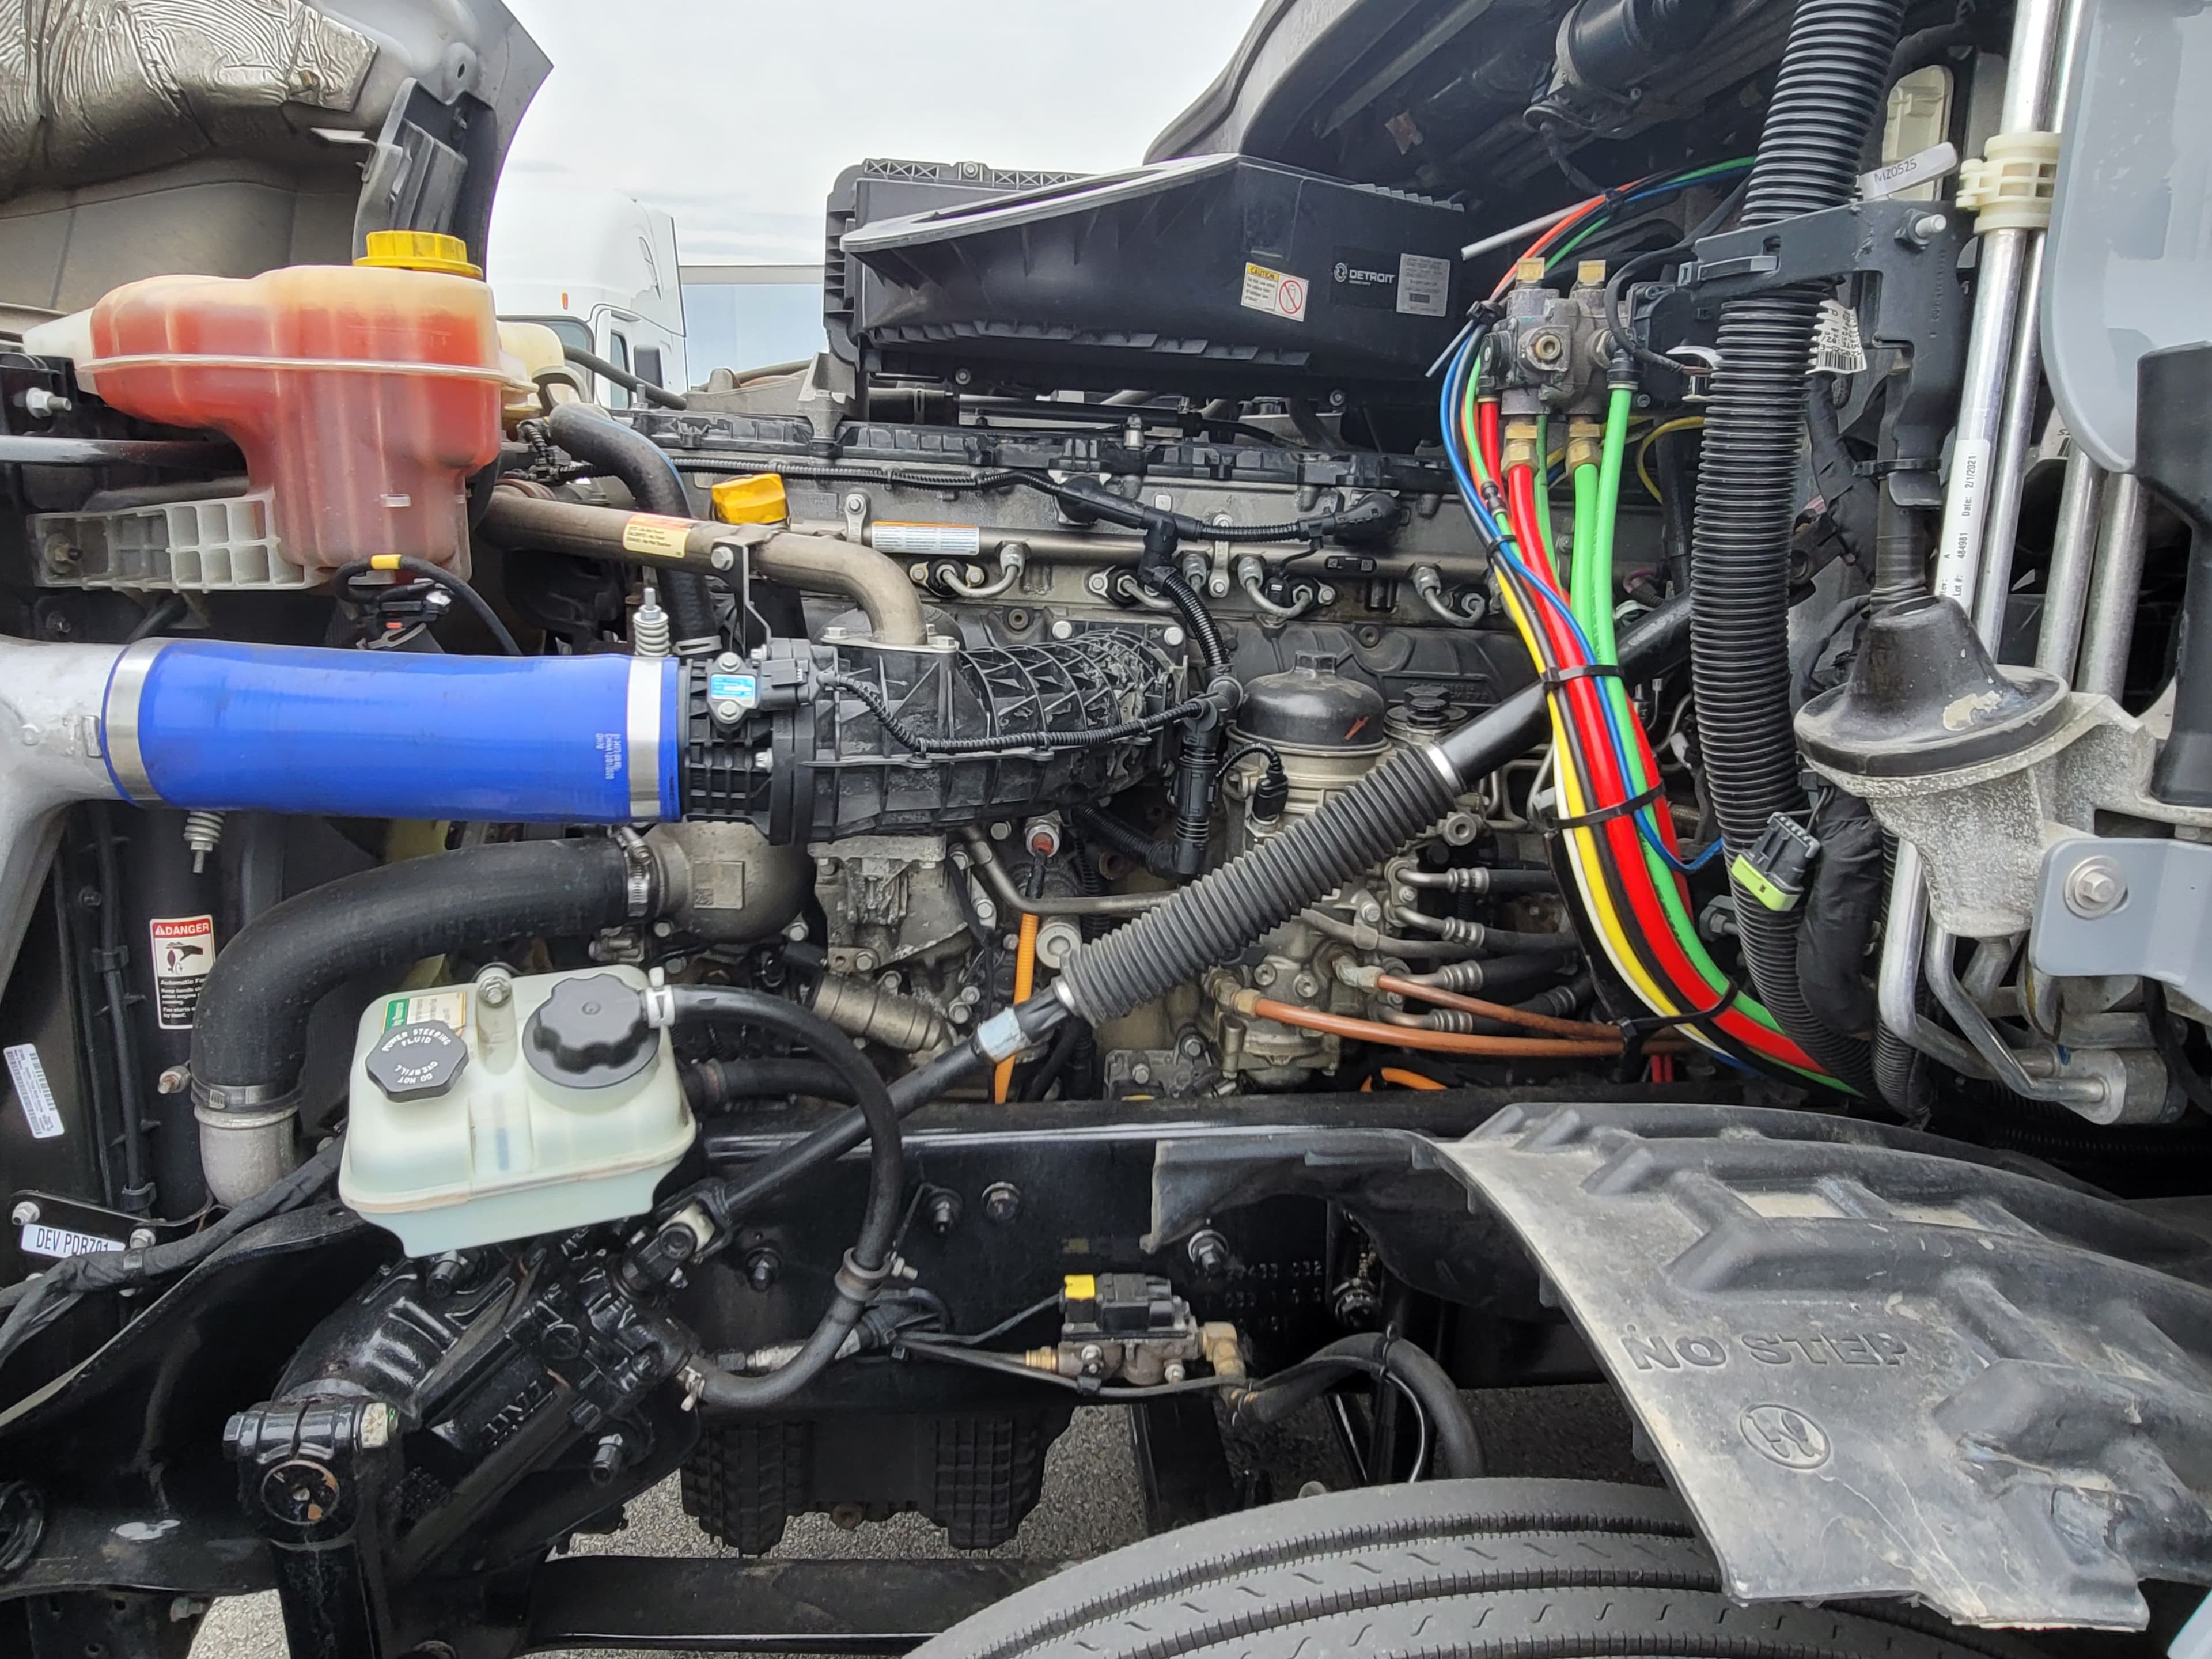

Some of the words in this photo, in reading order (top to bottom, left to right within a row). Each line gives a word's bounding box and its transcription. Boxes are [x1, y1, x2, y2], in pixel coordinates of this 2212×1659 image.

[1874, 158, 1918, 183] MZ0525
[1250, 267, 1275, 279] CAUTION
[1349, 270, 1396, 283] DETROIT
[1964, 456, 1977, 488] 2/1/2021
[1961, 496, 1972, 517] Date:
[1956, 532, 1968, 559] 484981
[1952, 582, 1963, 597] Lot
[165, 922, 209, 935] DANGER
[381, 1032, 408, 1052] POWER
[413, 1028, 452, 1046] STEERING
[401, 1036, 432, 1047] FLUID
[395, 1060, 438, 1077] OVERFILL
[397, 1076, 417, 1084] NOT
[421, 1073, 433, 1082] DO
[36, 1228, 61, 1251] DEV
[1620, 1335, 1727, 1370] NO
[1741, 1332, 1908, 1366] STEP
